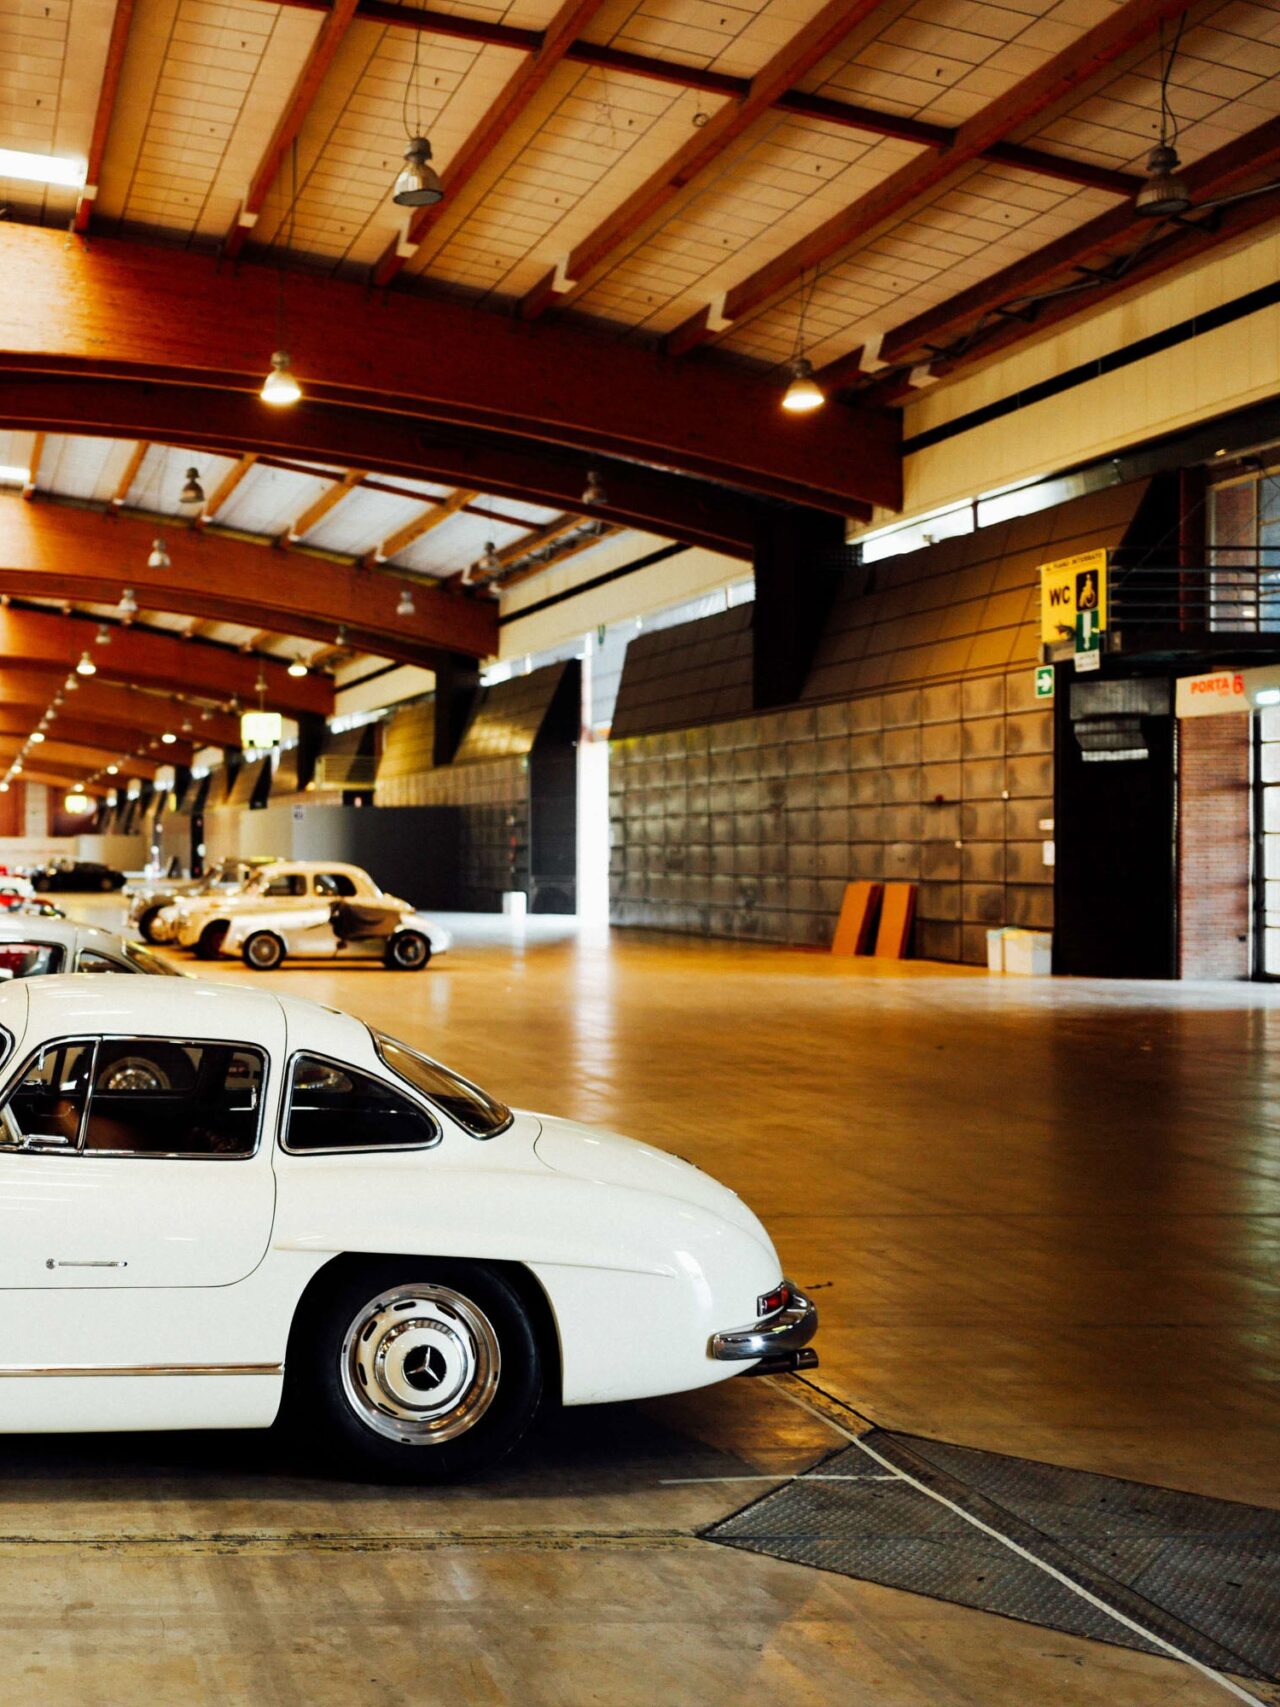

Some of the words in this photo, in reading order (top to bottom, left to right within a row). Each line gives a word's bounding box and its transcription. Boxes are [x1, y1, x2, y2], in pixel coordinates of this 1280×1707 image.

[1049, 585, 1071, 607] WC
[1190, 677, 1230, 694] PORTA
[1232, 674, 1245, 694] 6
